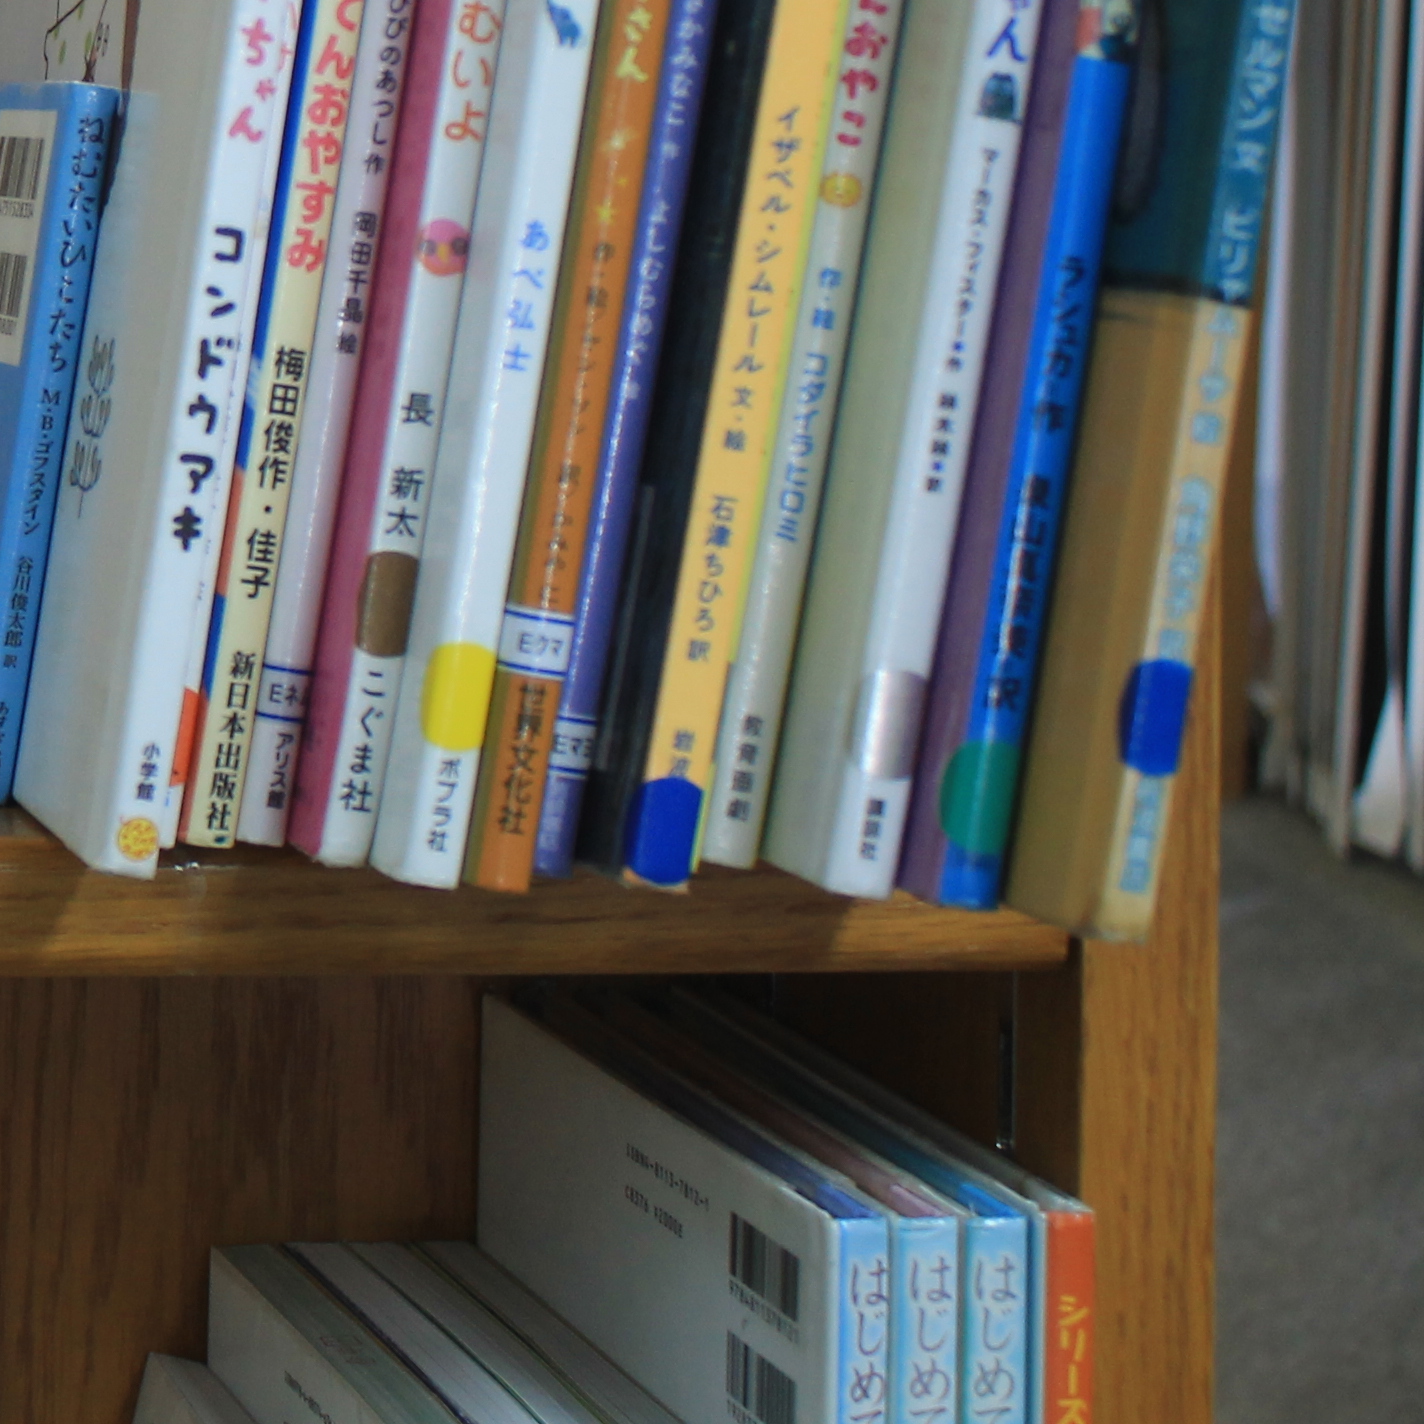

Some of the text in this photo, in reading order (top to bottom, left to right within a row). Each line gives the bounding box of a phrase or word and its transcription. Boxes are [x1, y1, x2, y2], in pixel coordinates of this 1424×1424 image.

[503, 220, 550, 372] あべ弘士
[734, 105, 802, 374] イザベル・シムレール
[172, 226, 244, 552] コンドウアキ
[775, 352, 828, 544] コダイラヒロミ
[241, 345, 308, 599] 梅田俊作・佳子
[4, 555, 34, 648] 谷川俊太郎
[694, 493, 740, 631] 石津ちひろ
[519, 632, 564, 657] Eクマ
[135, 741, 162, 801] 小学館
[206, 650, 257, 833] 新日本出版社
[339, 670, 387, 815] こぐま社
[427, 757, 462, 853] ポプラ社
